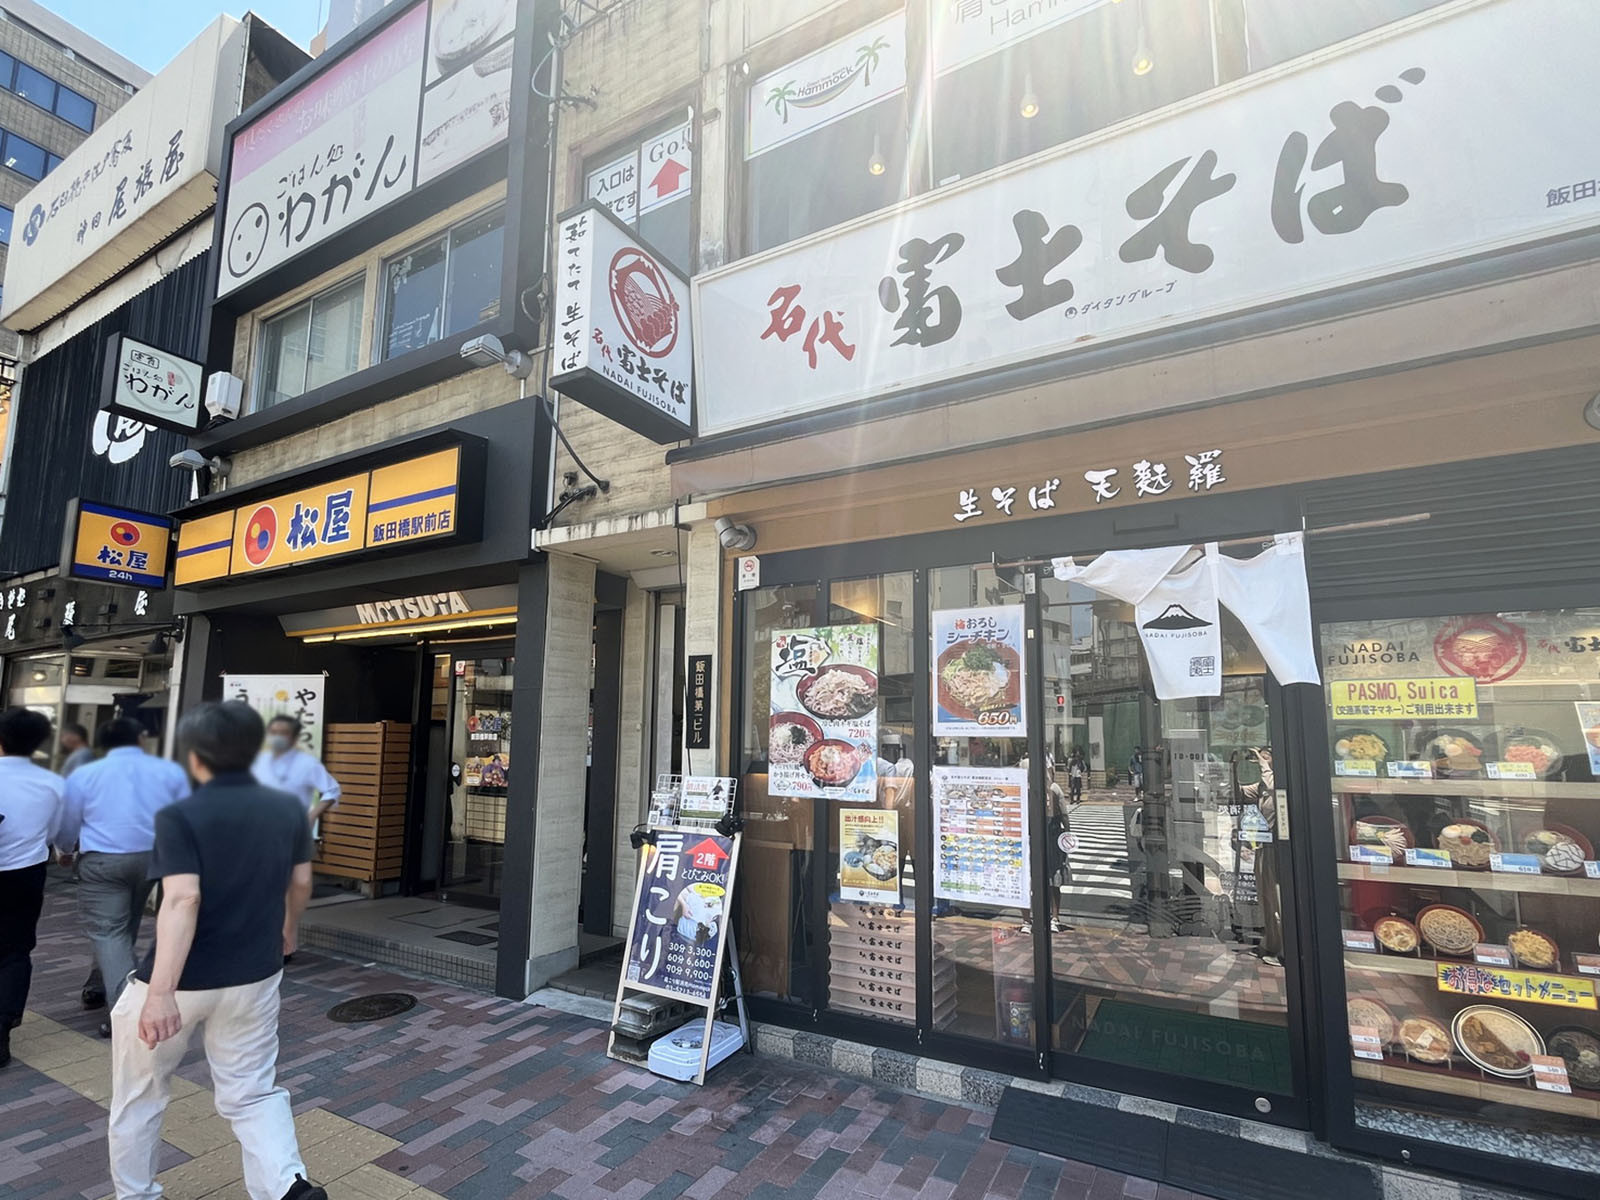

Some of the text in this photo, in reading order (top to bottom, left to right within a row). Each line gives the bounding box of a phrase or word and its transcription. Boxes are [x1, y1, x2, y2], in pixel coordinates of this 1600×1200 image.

[797, 65, 853, 97] Hammock
[108, 129, 184, 225] 尾張屋
[277, 144, 344, 199] ごはん処
[596, 165, 635, 197] 入口は
[278, 134, 408, 248] わがん
[1546, 179, 1600, 208] 飯田
[760, 66, 1426, 370] 名代 富士そば
[1081, 280, 1178, 314] ダイタングループ
[124, 373, 195, 410] わがん
[602, 365, 677, 415] NADAI FUJISOBA
[616, 344, 690, 405] 富士そば
[953, 478, 1061, 522] 生そば
[287, 490, 355, 551] 松屋
[372, 509, 452, 543] 飯田橋駅前店
[97, 546, 149, 571] 松屋
[108, 570, 133, 581] 24h
[355, 591, 470, 625] MATSUYA
[947, 629, 1010, 645] シーチキン
[1343, 641, 1404, 654] NADAI
[776, 635, 816, 675] 塩
[1328, 652, 1421, 665] FUJISOBA
[692, 660, 706, 744] 飯田橋第一ビル
[1348, 681, 1458, 702] PASMO, Suica
[978, 711, 1018, 725] 650円
[696, 852, 716, 867] 2階
[639, 833, 684, 980] 肩こり
[667, 953, 684, 964] 60分
[668, 942, 685, 954] 30分
[665, 964, 683, 975] 90分
[1447, 966, 1593, 1003] お得なセットメニュー
[1152, 1029, 1265, 1061] FUJISOBA
